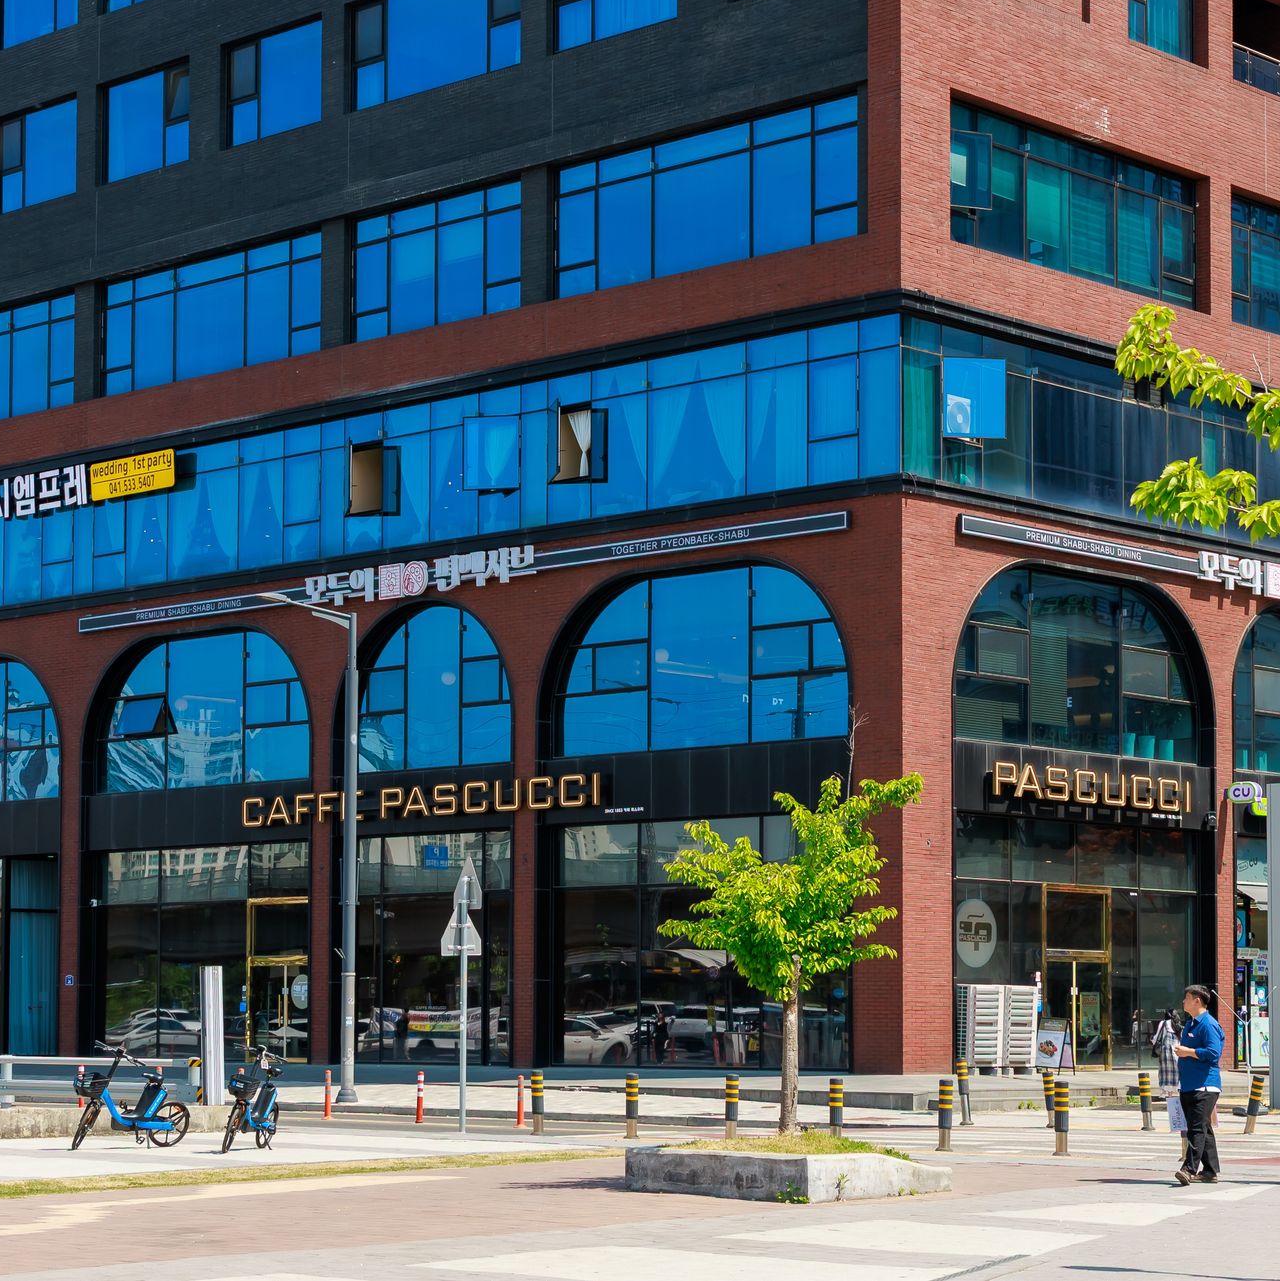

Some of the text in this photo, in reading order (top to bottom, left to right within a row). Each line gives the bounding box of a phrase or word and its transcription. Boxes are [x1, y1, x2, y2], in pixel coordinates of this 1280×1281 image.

[132, 457, 145, 472] 1st
[147, 452, 172, 470] party
[109, 474, 155, 495] 041.533.5407
[611, 526, 751, 556] TOGETHER PYEONBAEK-SHABU
[1026, 530, 1142, 562] PREMIUM SHABU-SHABU DINING
[304, 545, 536, 606] 모두의 편백샤브
[1198, 550, 1263, 595] 모두의
[136, 599, 242, 621] PREMIUM SHABU-SHABU DINING
[379, 771, 602, 821] PASCUCCI
[991, 760, 1193, 814] PASCUCCI
[1232, 787, 1251, 798] CU
[1249, 858, 1258, 867] CU
[959, 934, 988, 943] PASCUCCI
